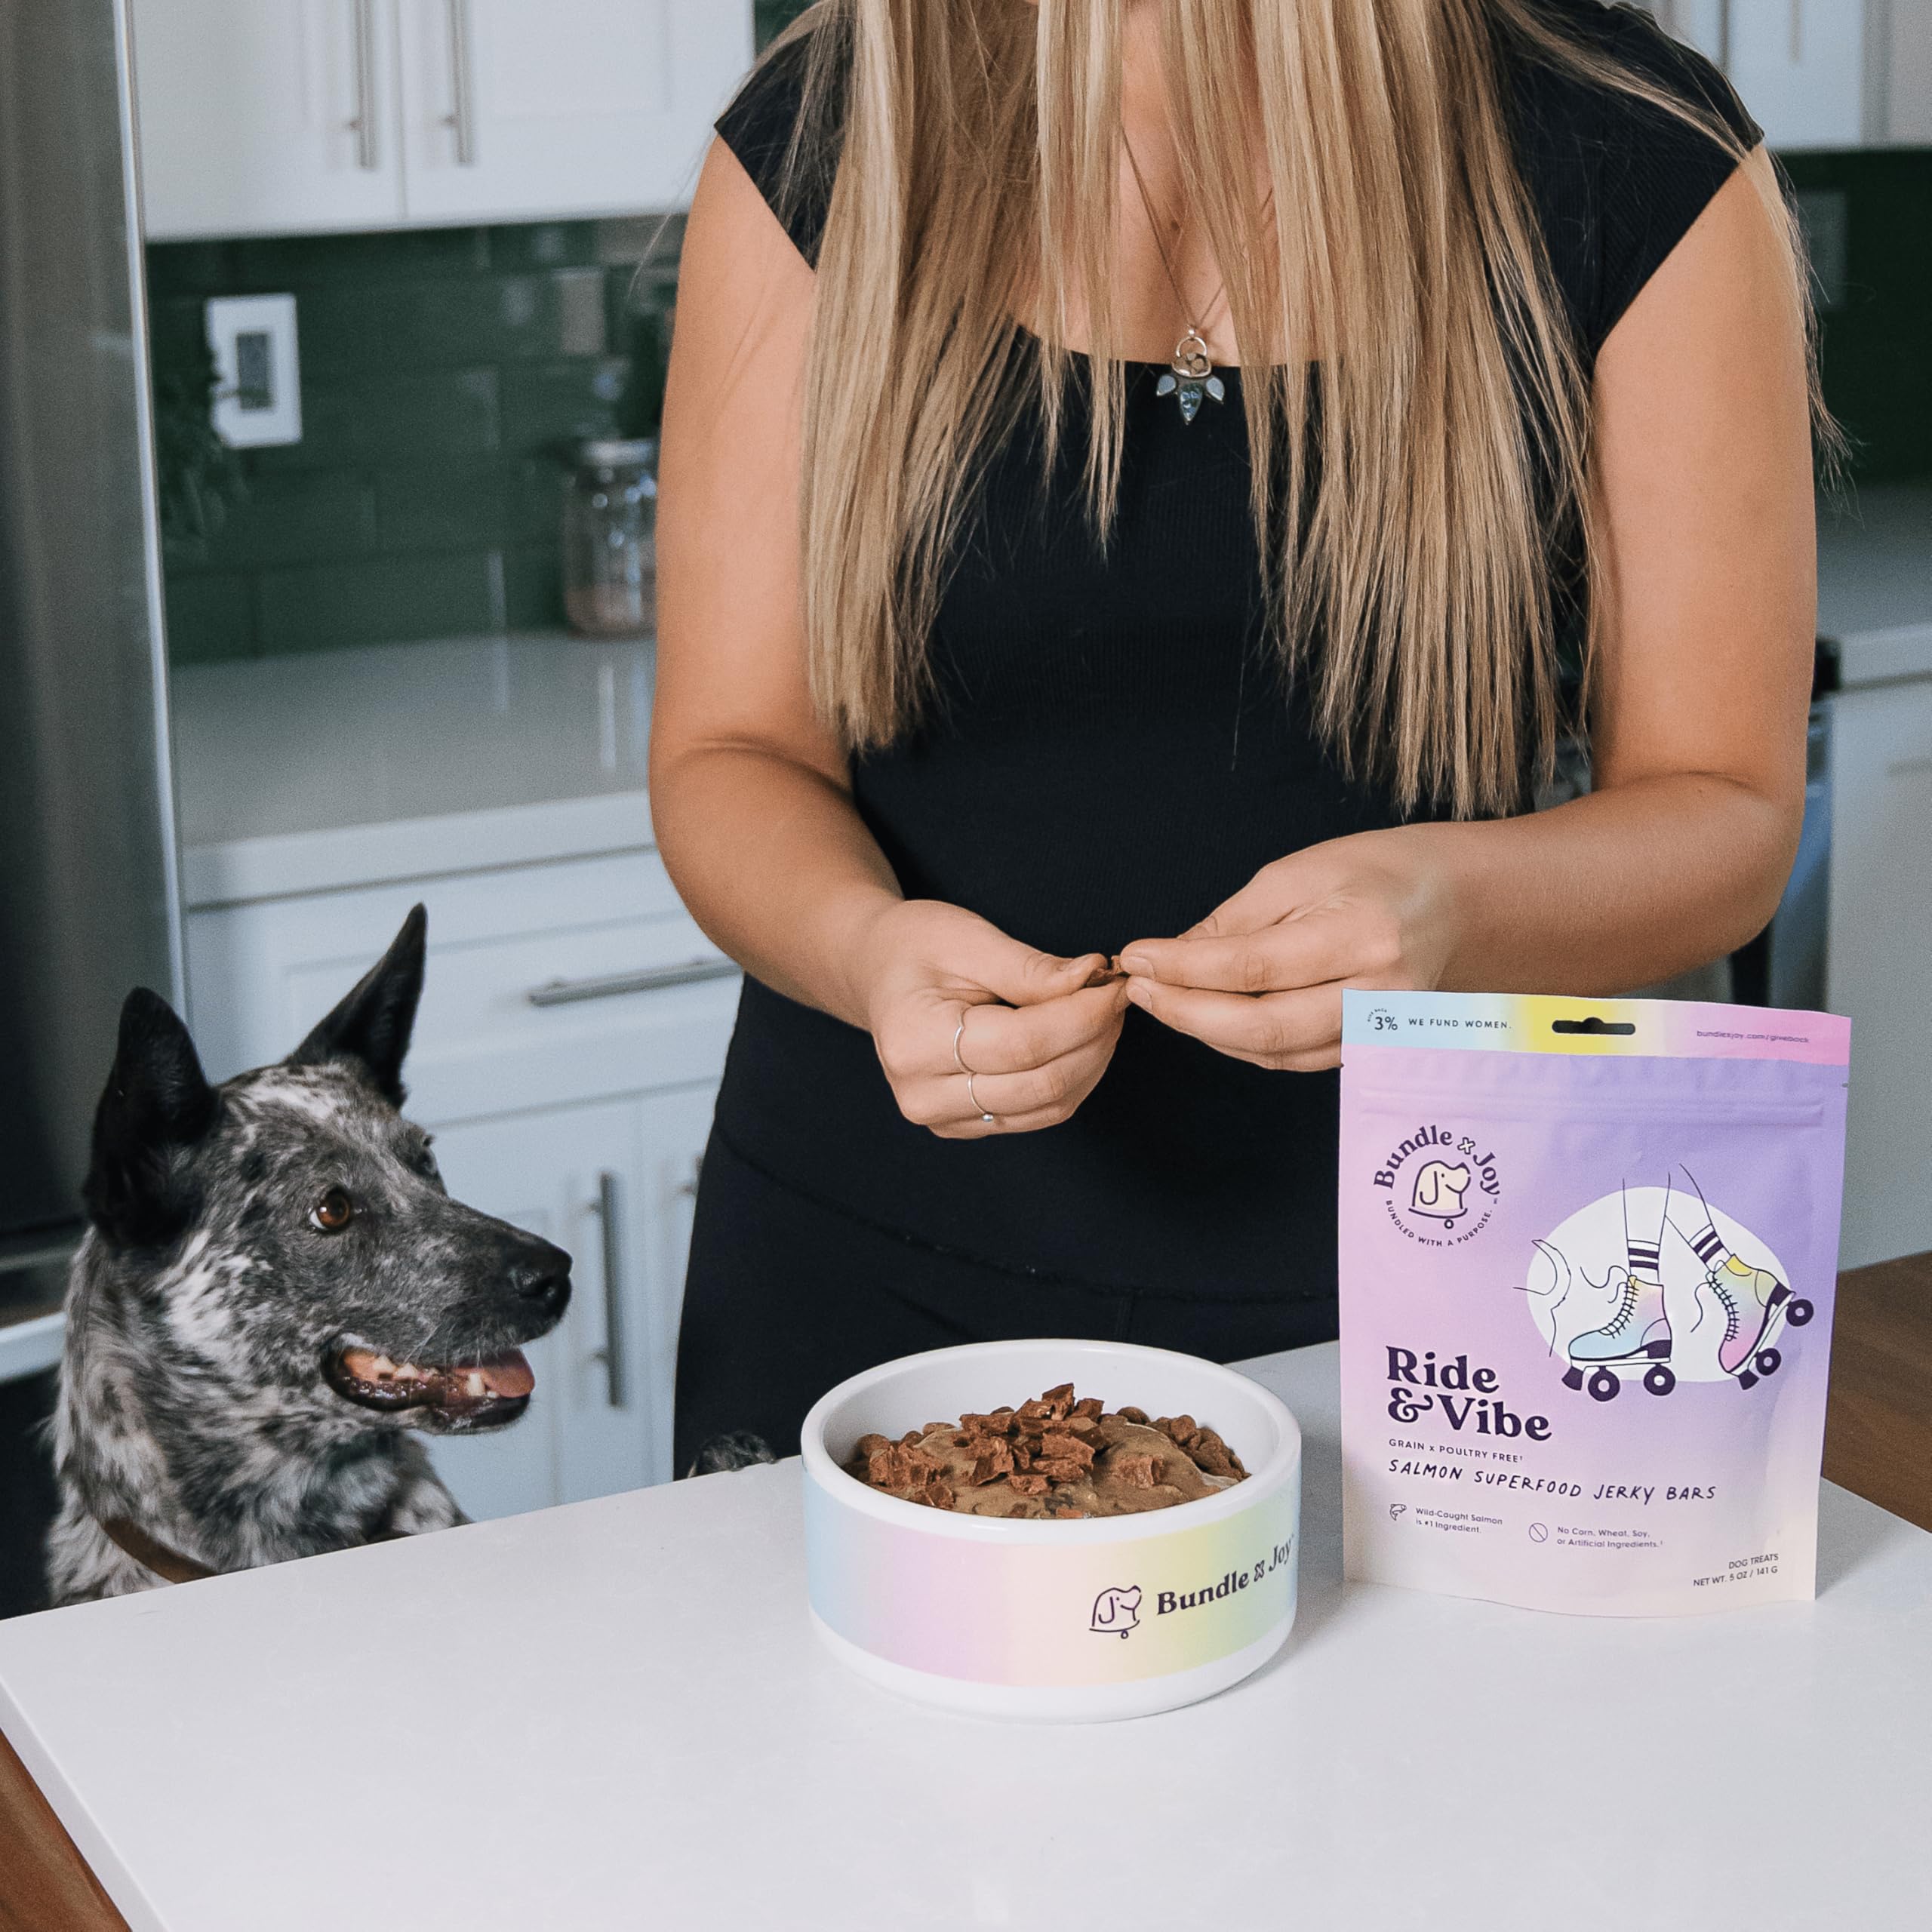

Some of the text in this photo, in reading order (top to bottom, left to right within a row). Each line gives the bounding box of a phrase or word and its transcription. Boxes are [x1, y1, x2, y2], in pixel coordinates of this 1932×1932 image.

[1375, 1016, 1398, 1030] 3%
[1430, 1019, 1460, 1027] FUND
[1464, 1020, 1512, 1029] WOMEN.
[1373, 1124, 1454, 1189] Bundle
[1472, 1152, 1500, 1195] Joy
[1386, 1200, 1415, 1238] BUNDLED
[1418, 1235, 1442, 1247] WITH
[1457, 1209, 1493, 1244] PURPOSE.
[1386, 1346, 1500, 1394] Ride
[1387, 1387, 1553, 1441] & Vibe
[1389, 1438, 1425, 1451] GRAIN
[1439, 1445, 1488, 1458] POULTRY
[1389, 1460, 1717, 1504] SALMON SUPERFOOD JERKY BARS
[1416, 1507, 1503, 1524] Wild-Caught Salmon
[1557, 1526, 1570, 1534] No
[1568, 1539, 1605, 1548] Artificial
[1728, 1553, 1780, 1570] DOG TREATS
[1157, 1571, 1250, 1616] Bundle
[1269, 1539, 1291, 1572] Joy
[1693, 1565, 1779, 1586] NET WT. 5 OZ / 141 G
